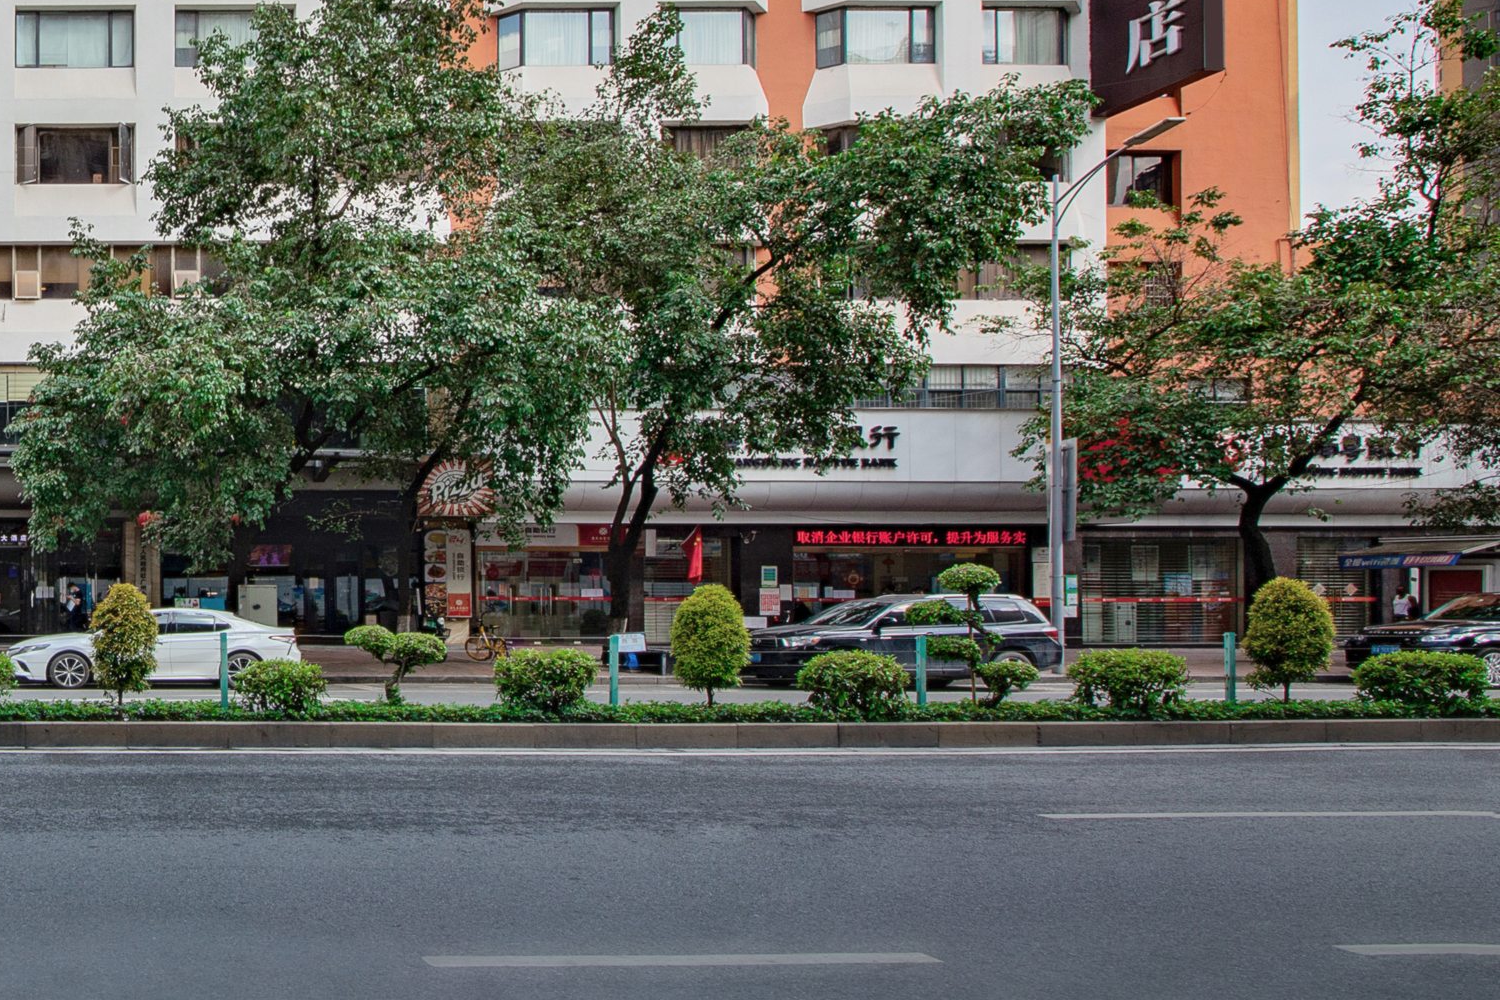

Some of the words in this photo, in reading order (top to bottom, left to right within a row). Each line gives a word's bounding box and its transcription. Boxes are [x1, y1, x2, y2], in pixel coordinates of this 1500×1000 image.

[860, 458, 898, 468] BANK
[456, 552, 465, 581] 自助银行
